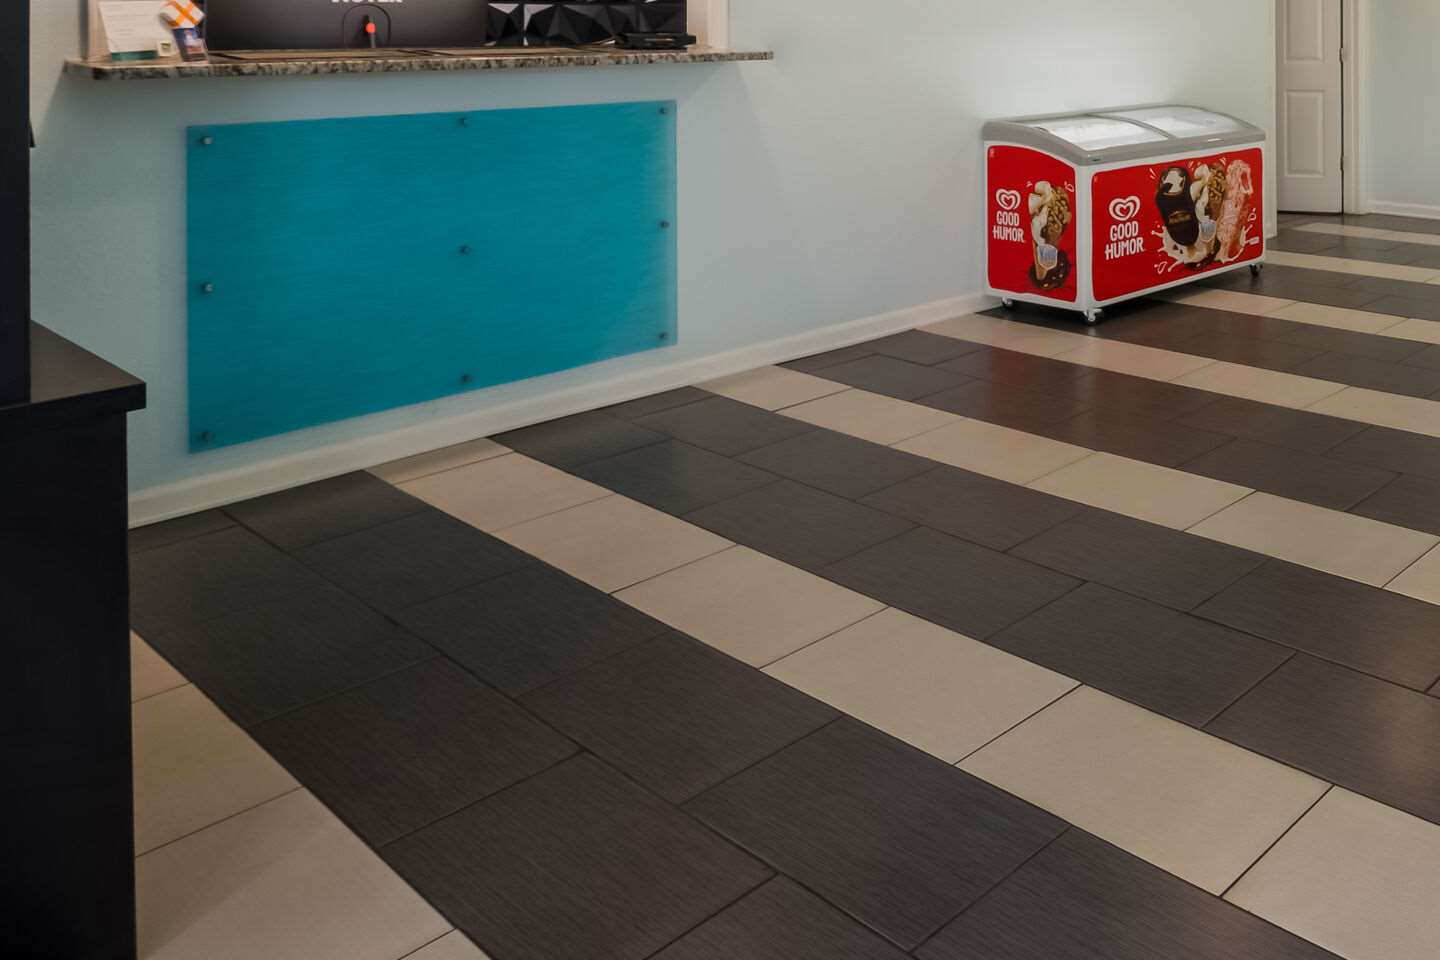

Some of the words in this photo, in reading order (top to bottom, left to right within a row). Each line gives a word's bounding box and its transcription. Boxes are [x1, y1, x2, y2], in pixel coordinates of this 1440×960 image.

[996, 210, 1020, 227] GOOD
[993, 225, 1024, 243] HUMOR
[1110, 221, 1138, 241] GOOD
[1105, 237, 1144, 260] HUMOR
